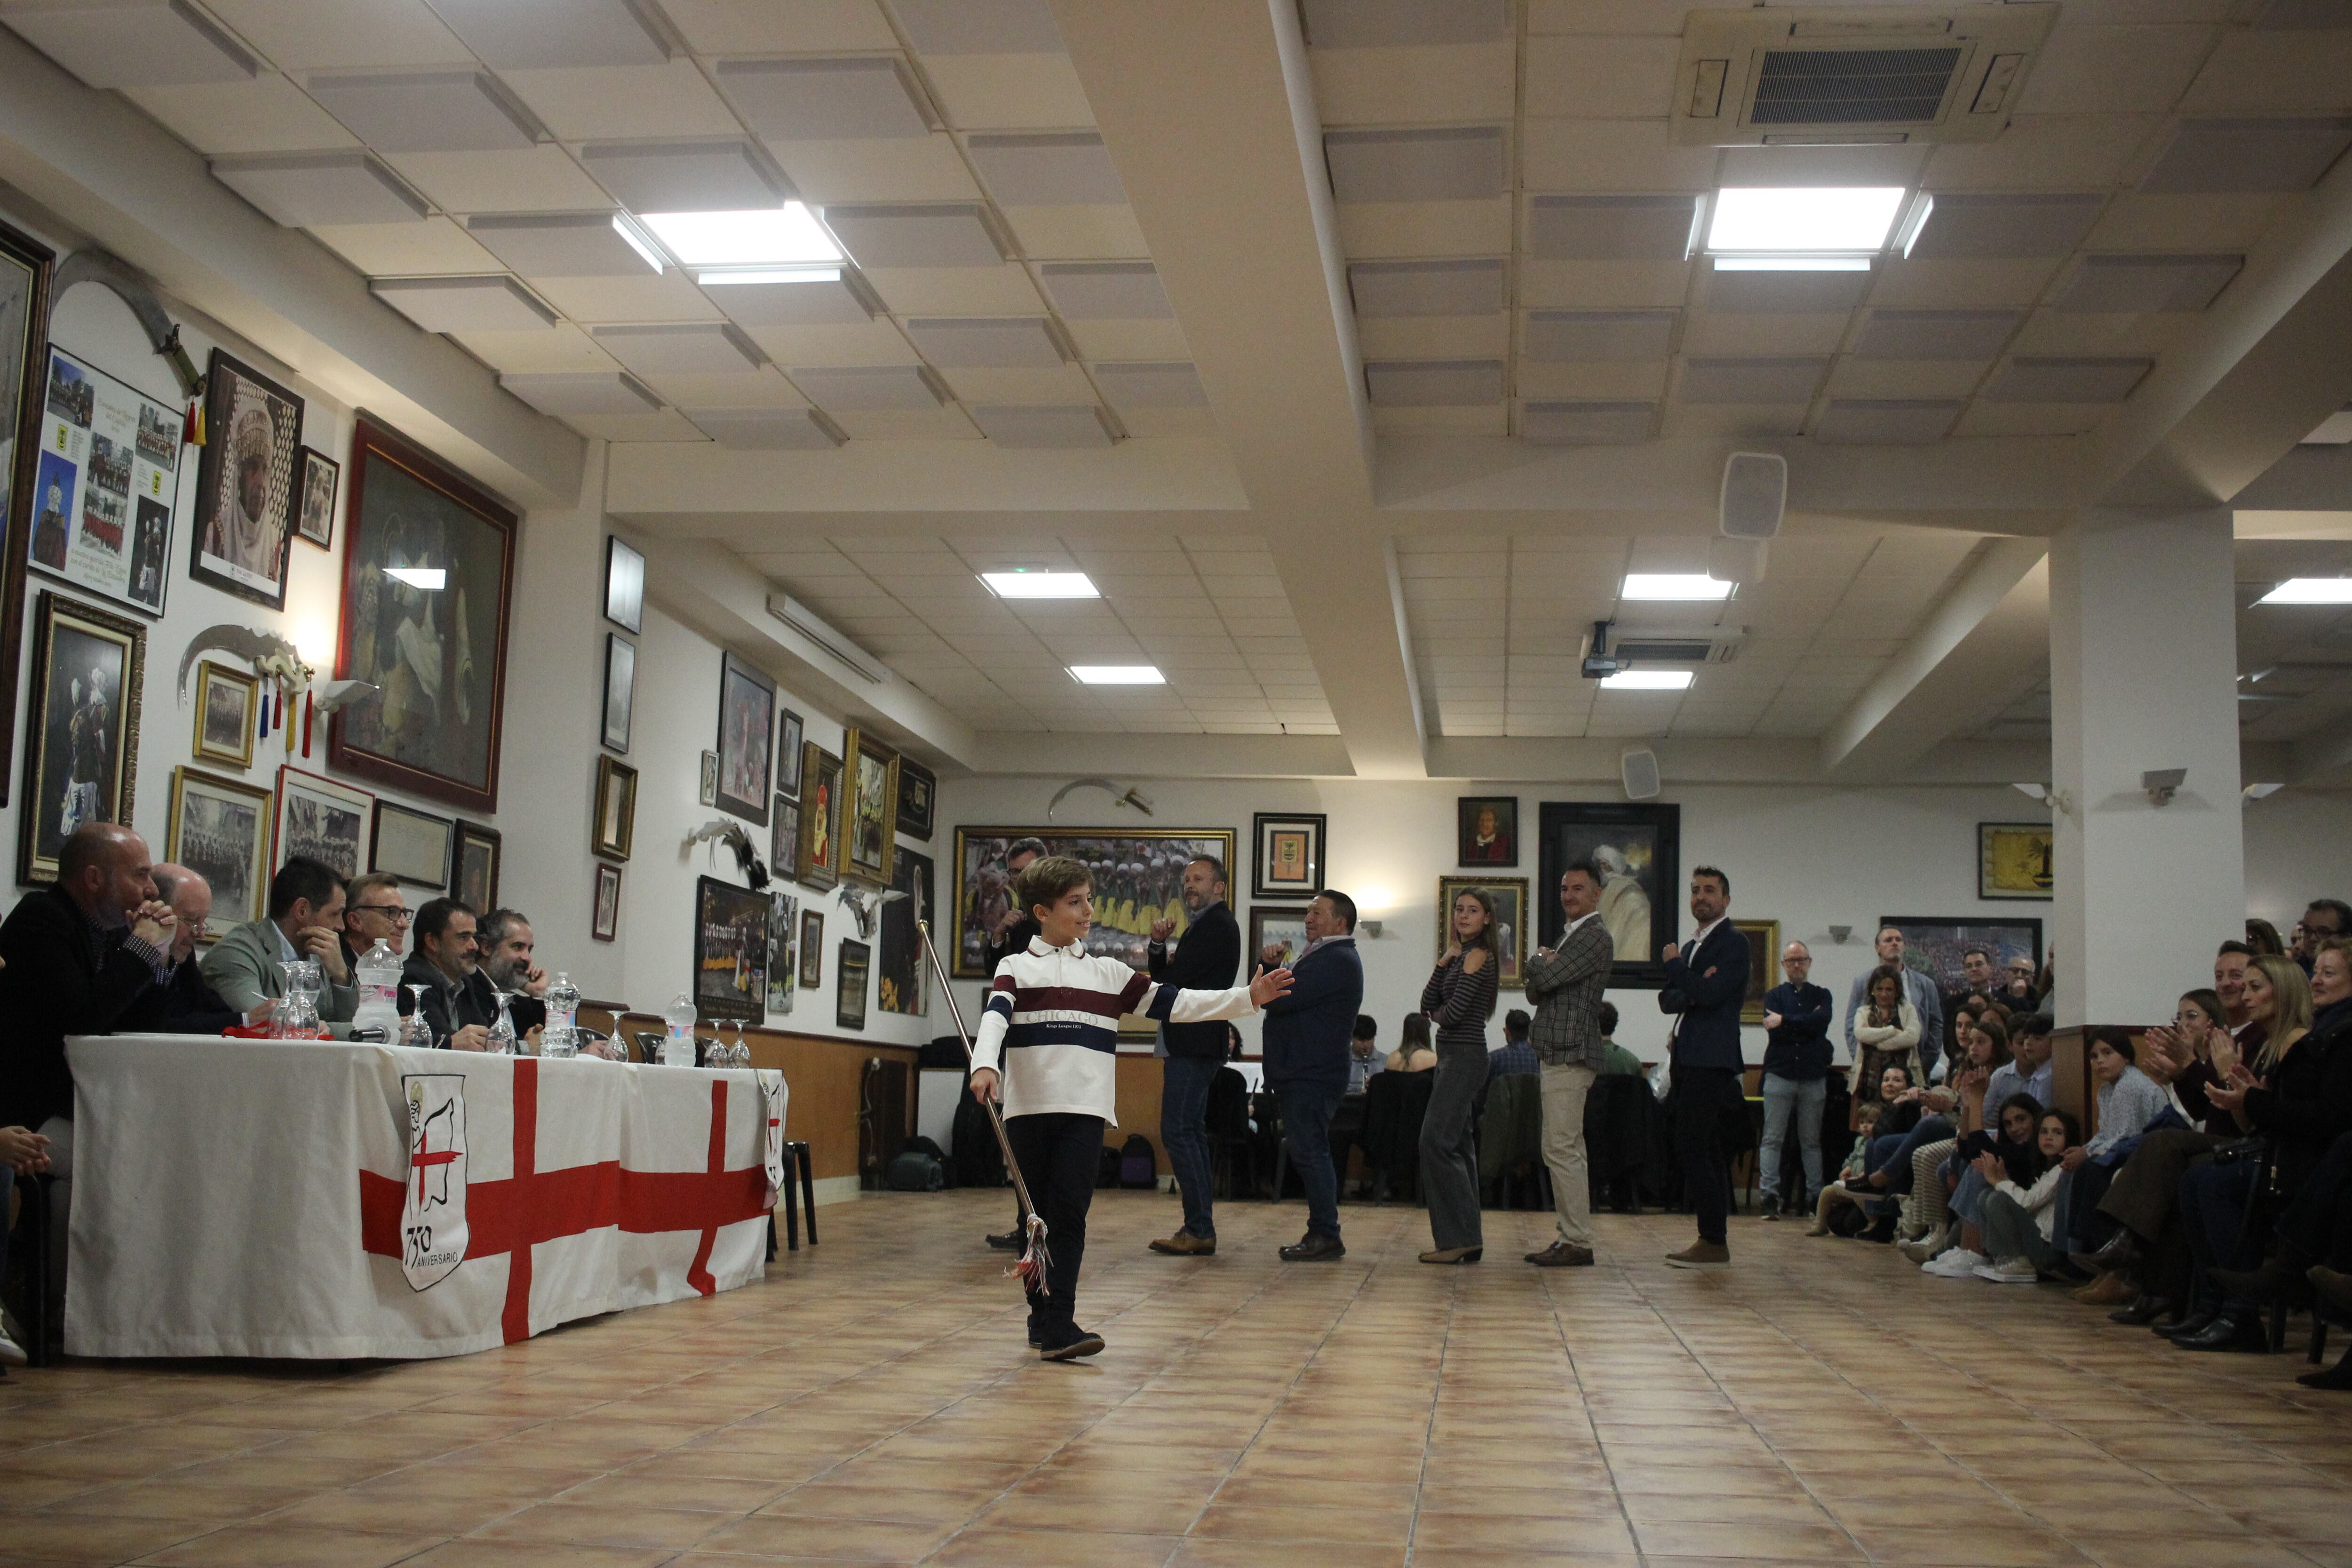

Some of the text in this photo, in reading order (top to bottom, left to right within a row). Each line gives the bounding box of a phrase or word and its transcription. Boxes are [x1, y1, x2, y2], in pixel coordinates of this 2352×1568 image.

[1027, 1011, 1098, 1026] CHICAGO
[405, 1226, 432, 1269] 750
[417, 1252, 458, 1267] ANIVERSARIO
